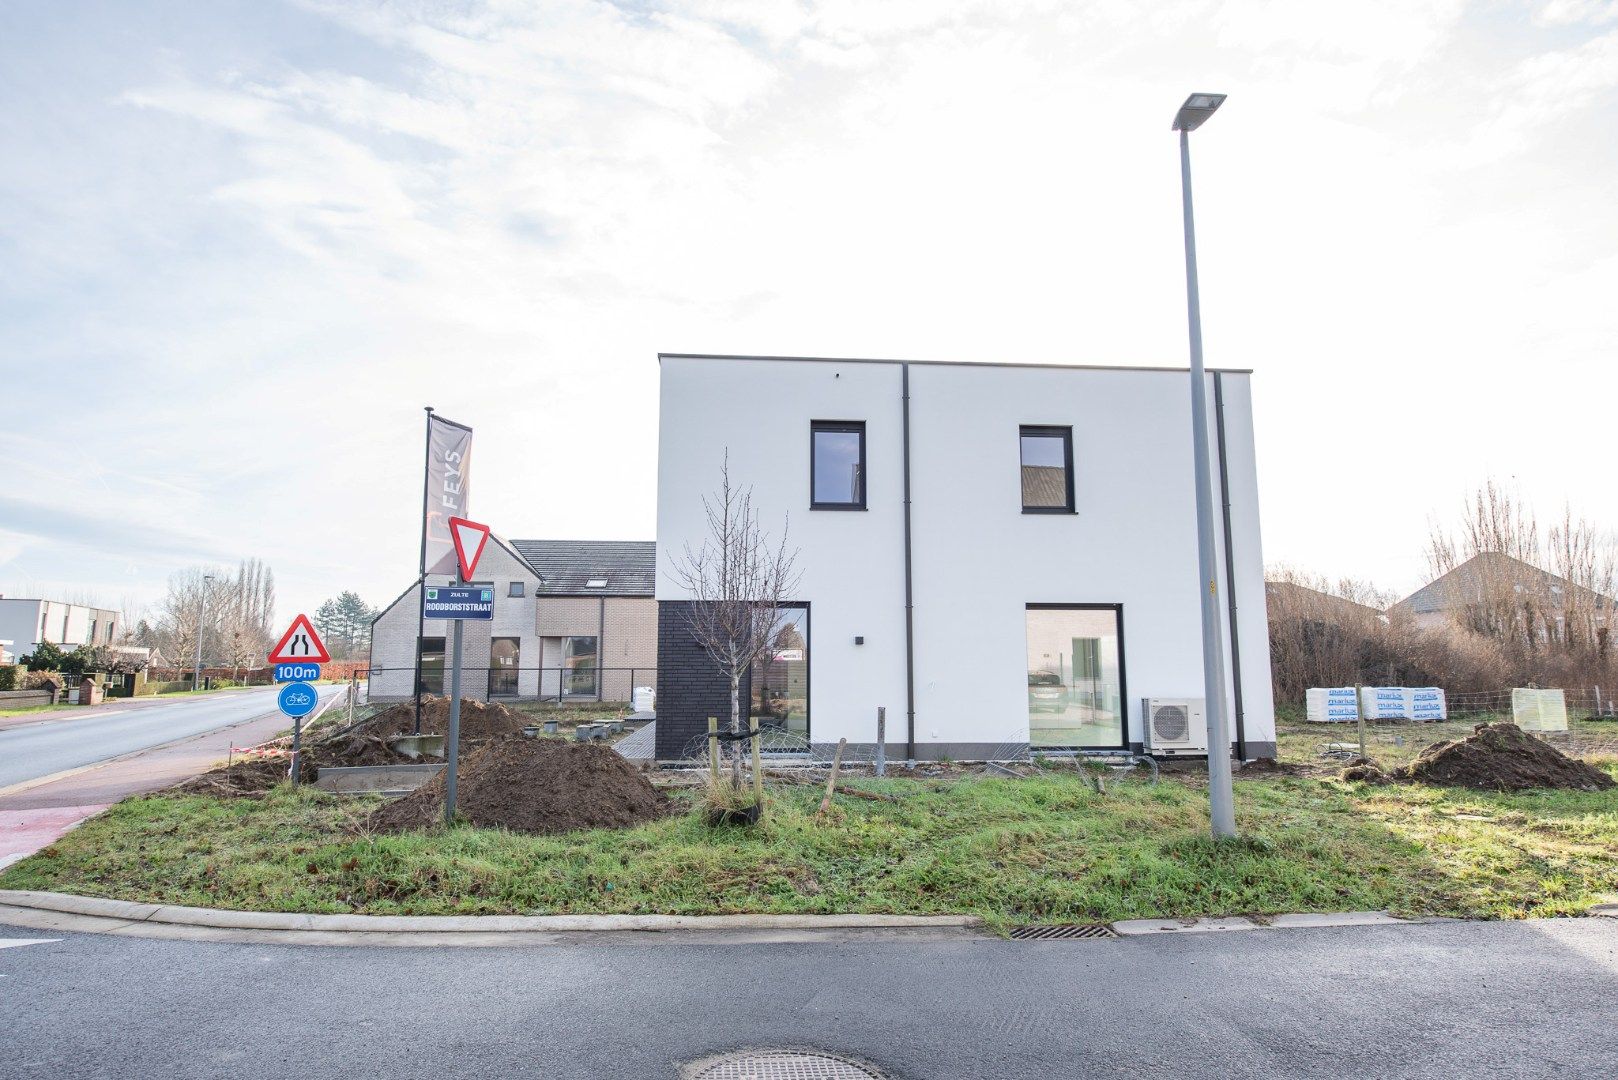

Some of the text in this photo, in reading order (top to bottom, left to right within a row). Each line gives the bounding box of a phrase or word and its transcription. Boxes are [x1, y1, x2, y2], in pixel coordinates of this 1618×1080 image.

[442, 449, 461, 510] FEYS
[426, 602, 492, 612] ROODBORSTSTRAAT
[278, 666, 317, 679] 100m
